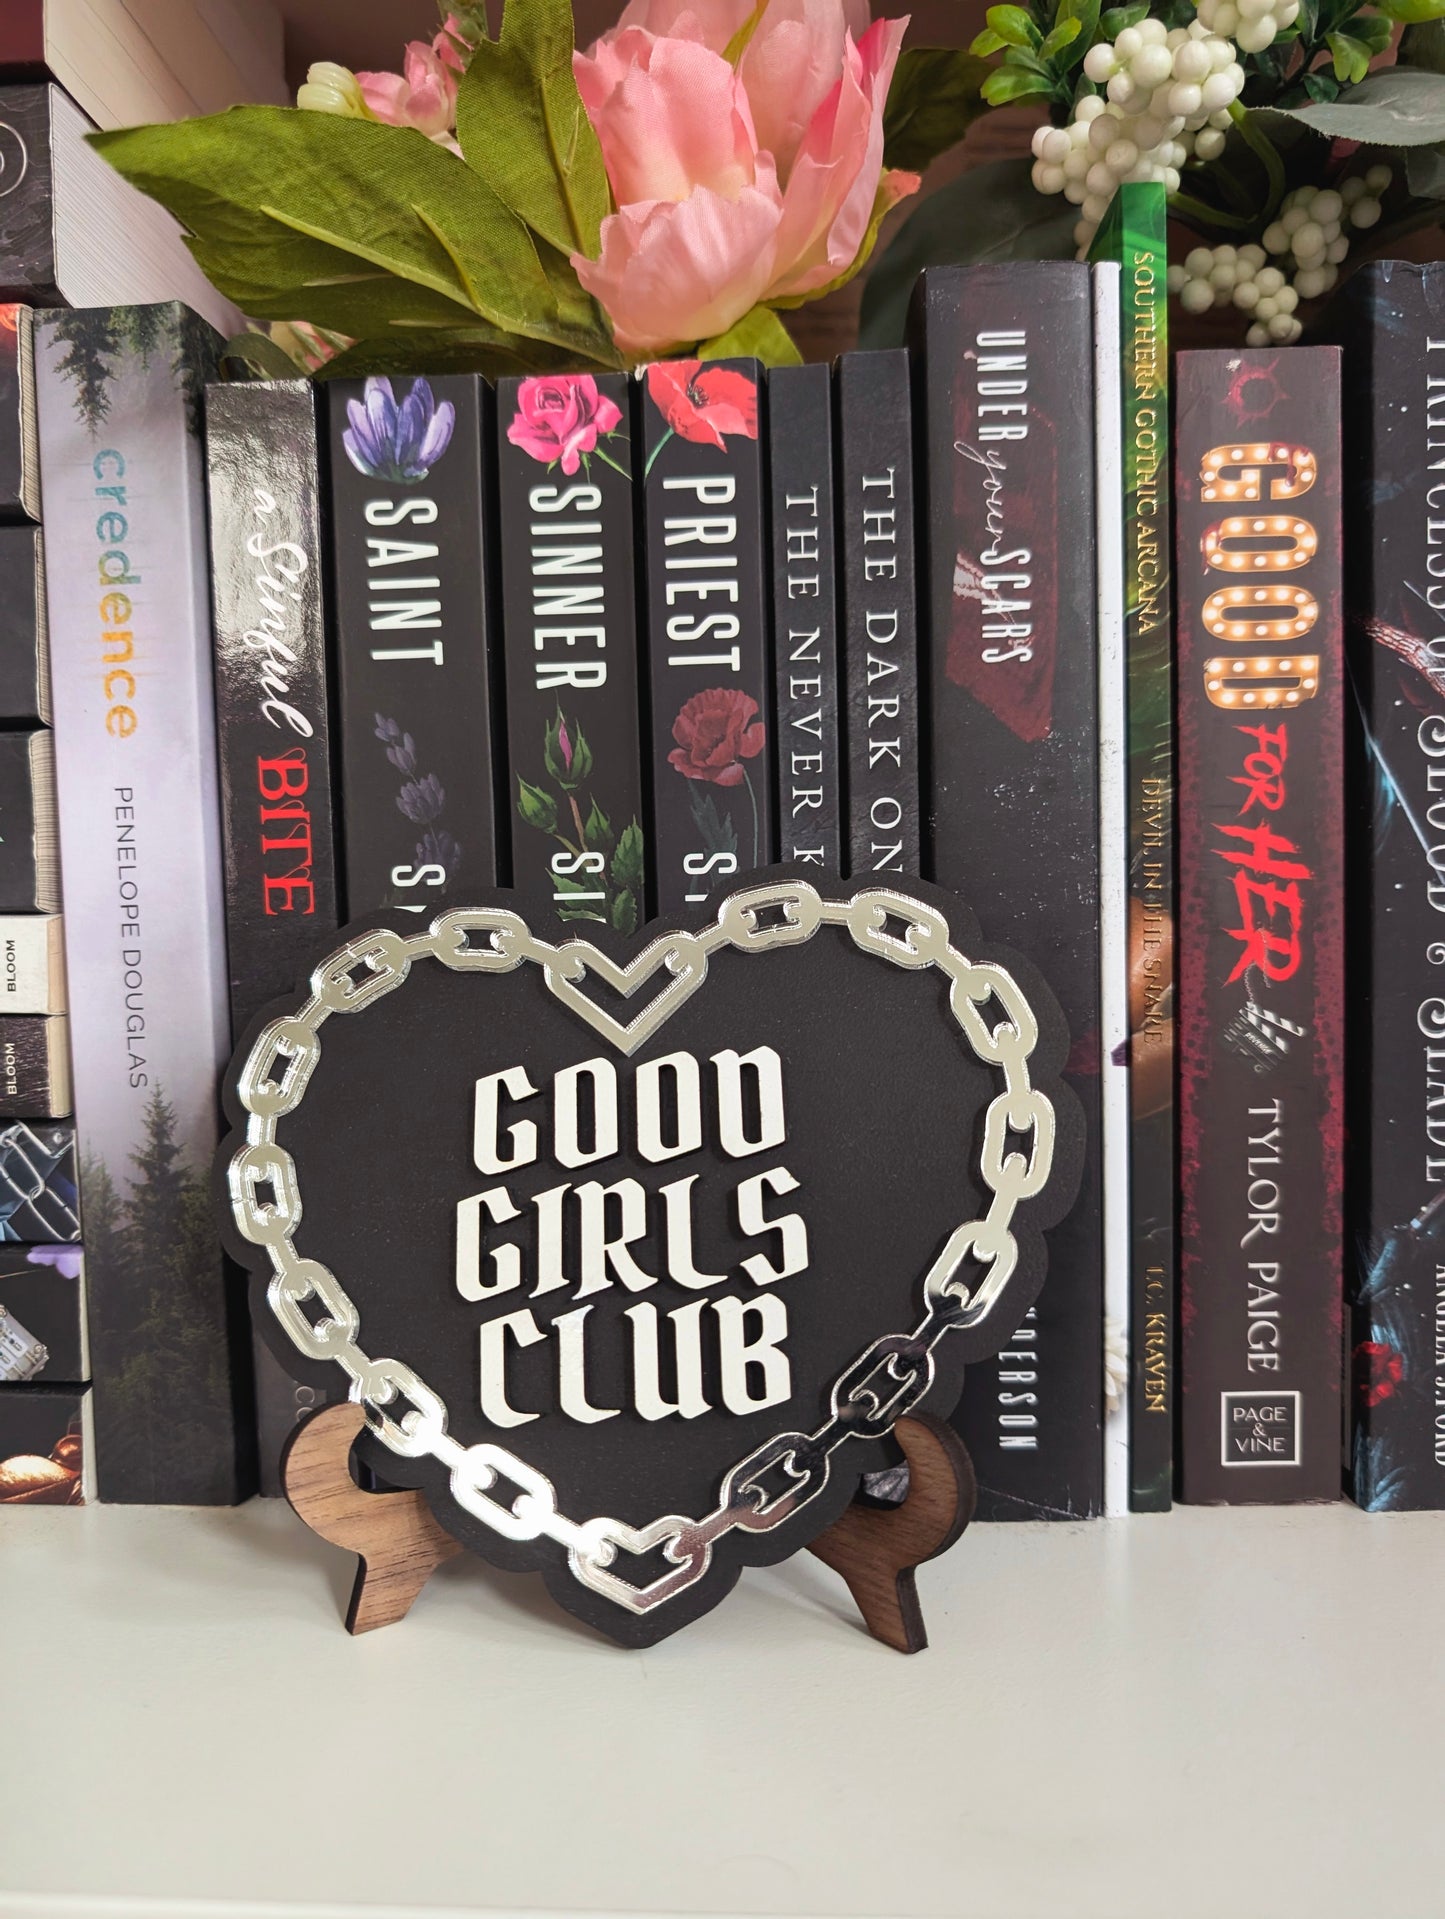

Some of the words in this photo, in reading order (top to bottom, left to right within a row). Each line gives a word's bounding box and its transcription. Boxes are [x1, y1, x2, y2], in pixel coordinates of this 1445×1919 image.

[1133, 251, 1157, 402] SOUTHERN
[975, 330, 1028, 441] UNDER
[254, 489, 277, 527] a
[953, 441, 1007, 555] your
[1134, 407, 1157, 517] GOTHIC
[364, 498, 444, 666] SAINT
[662, 475, 741, 672] PRIEST
[785, 486, 822, 600] THE
[861, 466, 898, 583] THE
[1136, 521, 1160, 636] ARCANA
[1199, 442, 1320, 710] GOOD
[92, 448, 142, 739] credence
[243, 532, 314, 739] Sinful
[528, 484, 607, 691] SINNER
[979, 548, 1034, 664] SCARS
[787, 626, 825, 819] NEVER
[865, 609, 902, 770] DARK
[1141, 777, 1163, 856] DEVIL
[1225, 721, 1289, 817] FOR
[114, 786, 142, 939] PENELOPE
[257, 747, 315, 916] BITE
[1142, 862, 1164, 890] IN
[1210, 818, 1314, 989] HER
[6, 940, 17, 993] BLOOM
[122, 949, 149, 1089] DOUGLAS
[5, 1043, 18, 1095] BLOOM
[473, 1045, 786, 1176] GOOD
[1240, 1097, 1281, 1250] TYLOR
[456, 1166, 809, 1302] GIRLS
[480, 1291, 792, 1429] CLUB
[1144, 1312, 1168, 1414] KRAVEN
[1247, 1261, 1281, 1374] PAIGE
[1233, 1406, 1288, 1422] PAGE
[1234, 1437, 1286, 1453] VINE
[1252, 1422, 1267, 1437] &
